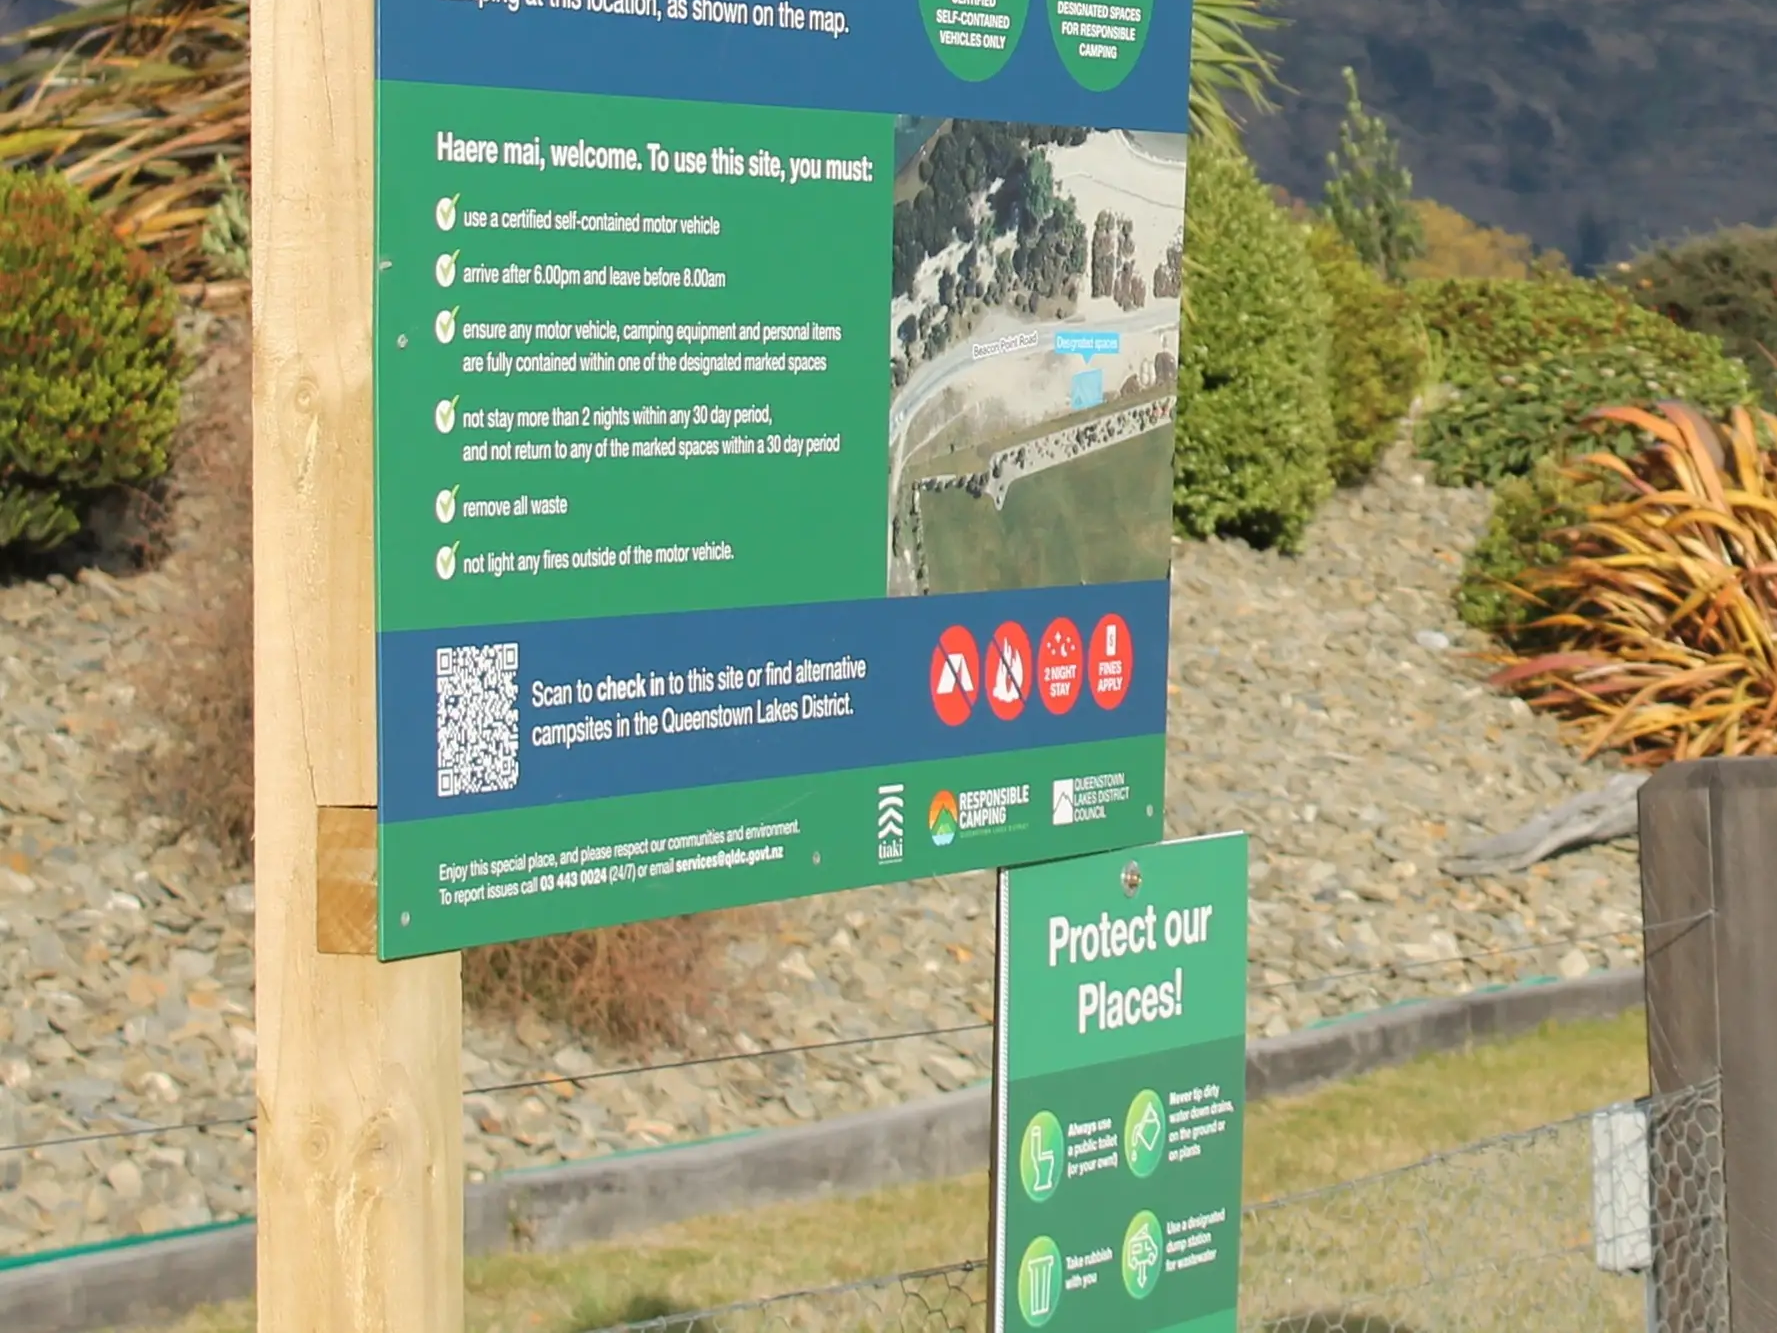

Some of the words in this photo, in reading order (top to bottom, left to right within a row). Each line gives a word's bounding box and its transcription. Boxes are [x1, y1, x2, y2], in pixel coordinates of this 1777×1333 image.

[752, 5, 774, 26] on
[778, 1, 805, 29] the
[809, 10, 849, 39] map.
[936, 9, 1010, 29] SELF-CONTAINED
[1057, 1, 1109, 18] DESIGNATED
[1109, 6, 1141, 22] SPACES
[940, 30, 982, 47] VEHICLES
[982, 34, 1006, 49] ONLY
[1062, 21, 1079, 35] FOR
[1080, 23, 1136, 41] RESPONSIBLE
[1079, 43, 1117, 59] CAMPING
[437, 131, 498, 163] Haere
[503, 137, 545, 171] mai,
[550, 139, 642, 170] welcome.
[646, 143, 669, 172] To
[674, 151, 707, 174] use
[710, 147, 744, 175] this
[748, 149, 785, 181] site,
[789, 157, 822, 182] you
[826, 156, 872, 181] must:
[464, 211, 488, 227] use
[490, 212, 499, 227] a
[501, 209, 552, 229] certified
[554, 211, 640, 232] self-contained
[642, 215, 678, 233] motor
[680, 215, 720, 235] vehicle
[463, 263, 500, 283] arrive
[502, 263, 532, 284] after
[534, 264, 581, 289] 6.00pm
[583, 266, 607, 285] and
[609, 266, 641, 286] leave
[643, 267, 681, 287] before
[683, 268, 726, 287] 8.00am
[462, 323, 507, 339] ensure
[509, 323, 532, 344] any
[535, 321, 573, 339] motor
[574, 320, 620, 342] vehicle,
[623, 321, 674, 345] camping
[676, 321, 737, 344] equipment
[738, 321, 760, 340] and
[762, 322, 810, 345] personal
[812, 322, 842, 341] items
[973, 343, 1000, 358] Beacon
[1000, 336, 1018, 353] Point
[1018, 332, 1038, 346] Road
[463, 409, 484, 428] not
[487, 409, 514, 432] stay
[517, 411, 550, 427] more
[552, 407, 579, 427] than
[582, 407, 590, 426] 2
[593, 406, 630, 430] nights
[632, 406, 667, 425] within
[669, 409, 691, 428] any
[692, 405, 708, 424] 30
[710, 405, 732, 427] day
[734, 404, 772, 427] period,
[463, 441, 488, 461] and
[490, 441, 512, 461] not
[514, 441, 552, 460] return
[554, 440, 568, 459] to
[570, 443, 592, 462] any
[595, 438, 608, 458] of
[610, 438, 630, 457] the
[632, 437, 676, 457] marked
[678, 440, 720, 459] spaces
[722, 435, 755, 454] within
[756, 439, 765, 454] a
[766, 435, 782, 453] 30
[783, 435, 804, 456] day
[806, 433, 840, 456] period
[463, 500, 511, 517] remove
[513, 495, 528, 515] all
[530, 495, 568, 515] waste
[464, 554, 485, 573] not
[488, 552, 515, 577] light
[517, 555, 540, 575] any
[542, 550, 570, 569] fires
[572, 547, 616, 568] outside
[618, 546, 631, 565] of
[633, 545, 653, 564] the
[655, 544, 690, 563] motor
[692, 542, 734, 561] vehicle.
[1044, 668, 1051, 681] 2
[1051, 665, 1076, 680] NIGHT
[1098, 660, 1122, 675] FINES
[532, 681, 572, 707] Scan
[576, 679, 593, 703] to
[596, 673, 646, 701] check
[650, 671, 665, 697] in
[668, 671, 684, 695] to
[687, 667, 714, 693] this
[718, 665, 744, 691] site
[747, 668, 762, 688] or
[765, 660, 792, 686] find
[795, 655, 866, 683] alternative
[1050, 681, 1071, 697] STAY
[1097, 676, 1123, 692] APPLY
[532, 716, 612, 749] campsites
[616, 713, 630, 737] in
[633, 711, 658, 736] the
[662, 705, 753, 733] Queenstown
[757, 698, 798, 723] Lakes
[802, 693, 854, 719] District.
[1074, 773, 1125, 792] QUEENSTOWN
[959, 785, 1029, 811] RESPONSIBLE
[1073, 790, 1097, 806] LAKES
[1098, 786, 1130, 803] DISTRICT
[959, 806, 1006, 829] CAMPING
[1074, 805, 1107, 822] COUNCIL
[878, 838, 903, 859] tiaki
[439, 888, 452, 905] To
[454, 885, 485, 906] report
[487, 883, 519, 899] issues
[520, 877, 538, 895] call
[540, 874, 555, 891] 03
[556, 871, 578, 889] 443
[580, 867, 608, 886] 0024
[608, 863, 636, 884] (24/7)
[637, 865, 648, 878] or
[649, 858, 674, 876] email
[675, 846, 783, 873] services@qldc.govt.nz
[1049, 905, 1157, 967] Protect
[1164, 905, 1212, 947] our
[1079, 968, 1182, 1034] Places!
[1169, 1091, 1193, 1105] Never
[1192, 1089, 1204, 1102] tip
[1202, 1085, 1219, 1098] dirty
[1068, 1122, 1098, 1137] Always
[1097, 1118, 1112, 1131] use
